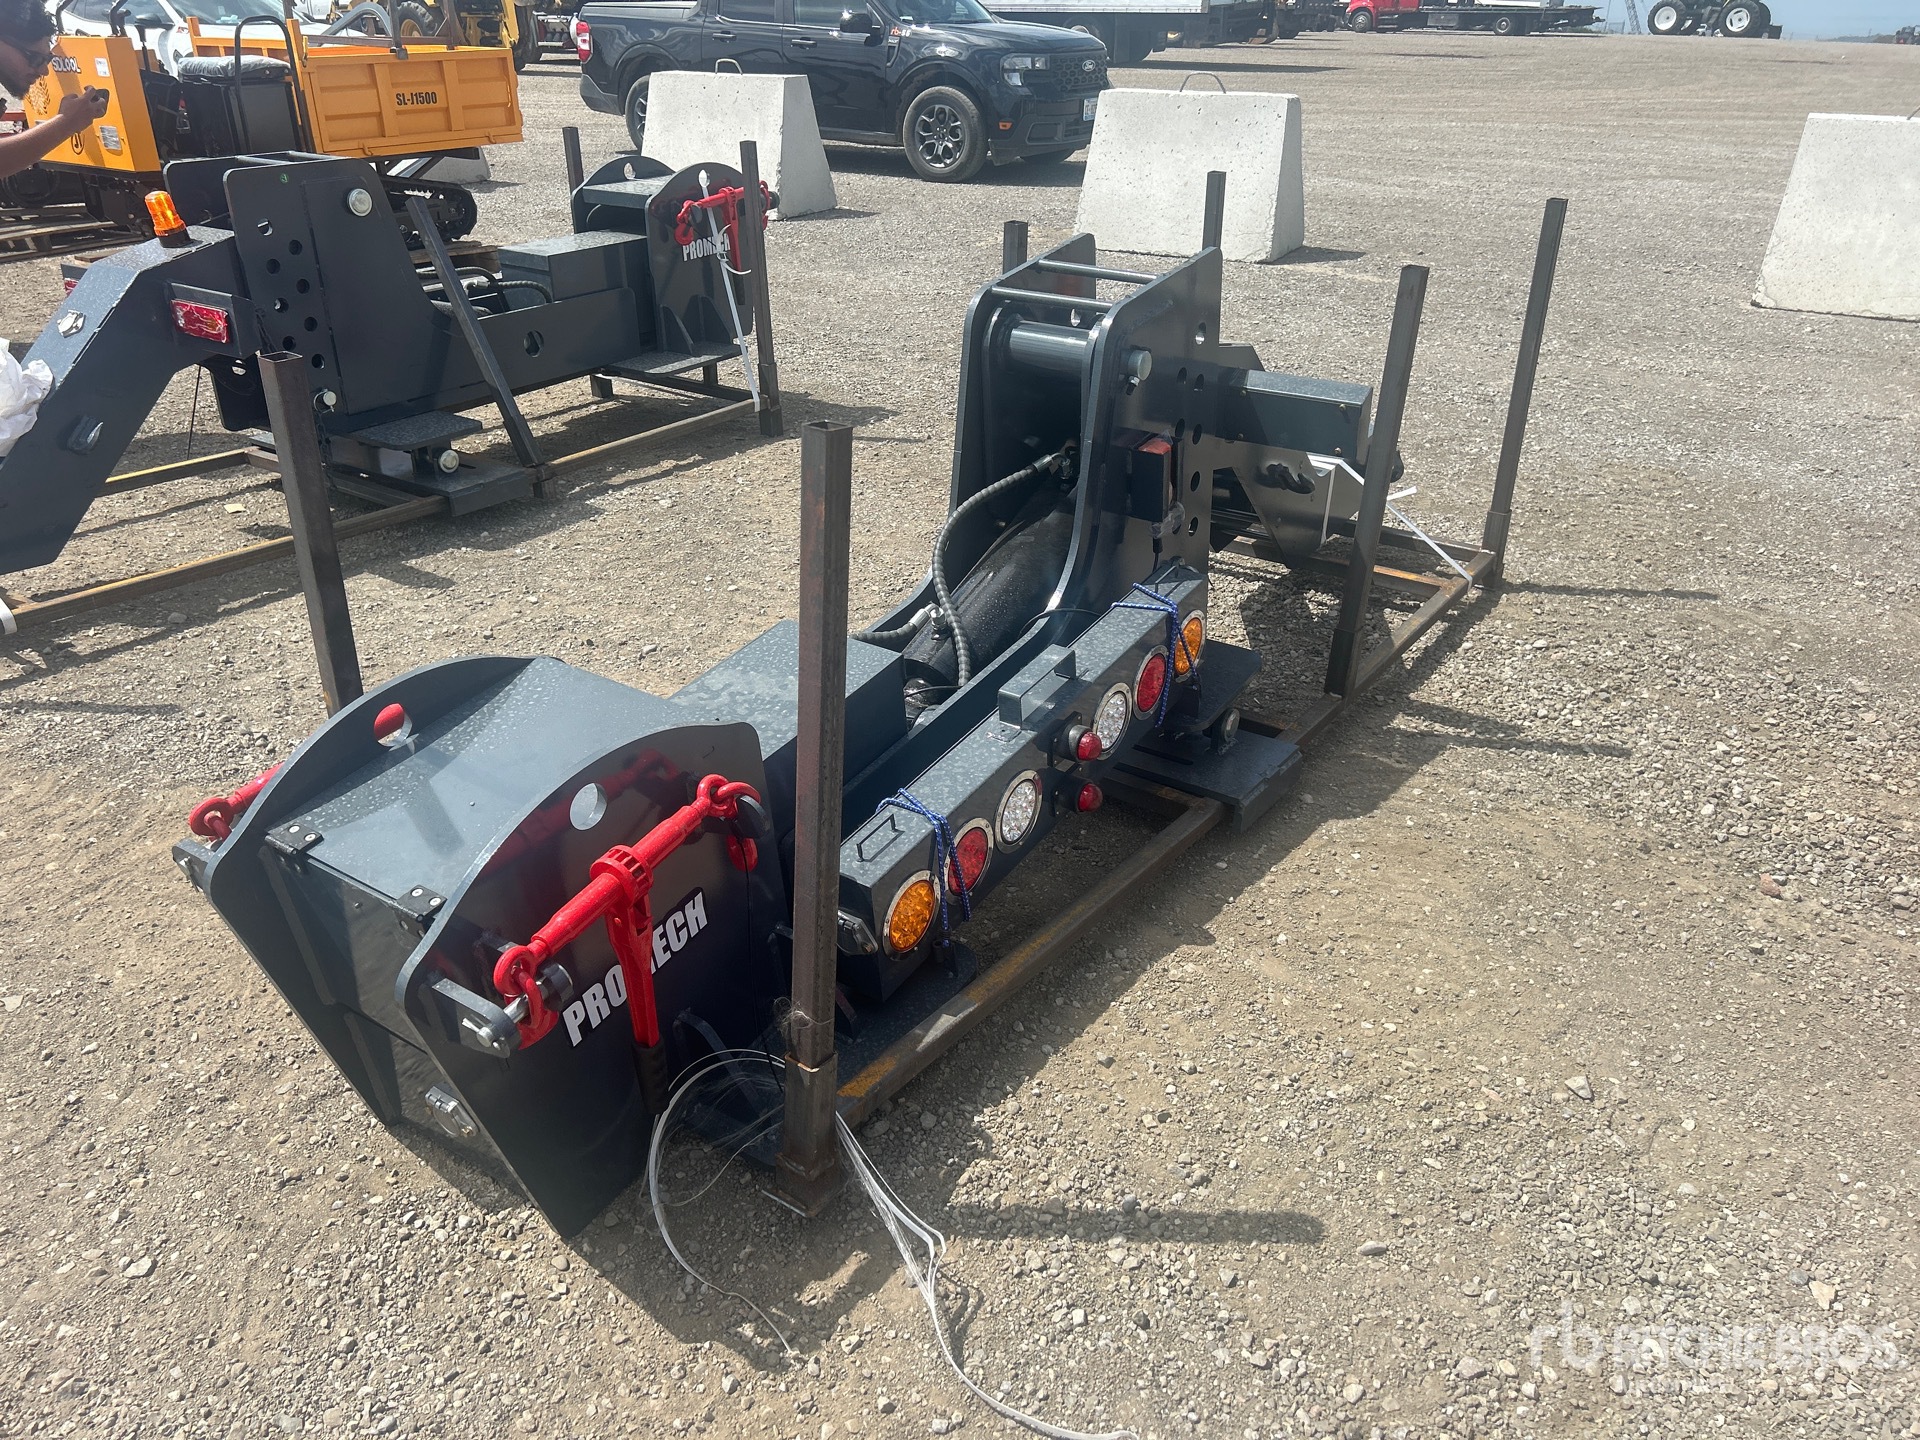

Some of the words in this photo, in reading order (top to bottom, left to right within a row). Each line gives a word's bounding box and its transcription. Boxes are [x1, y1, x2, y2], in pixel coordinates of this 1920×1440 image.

[395, 91, 438, 106] SL-J1500
[682, 233, 731, 262] PROMCH
[562, 891, 708, 1047] PROECH
